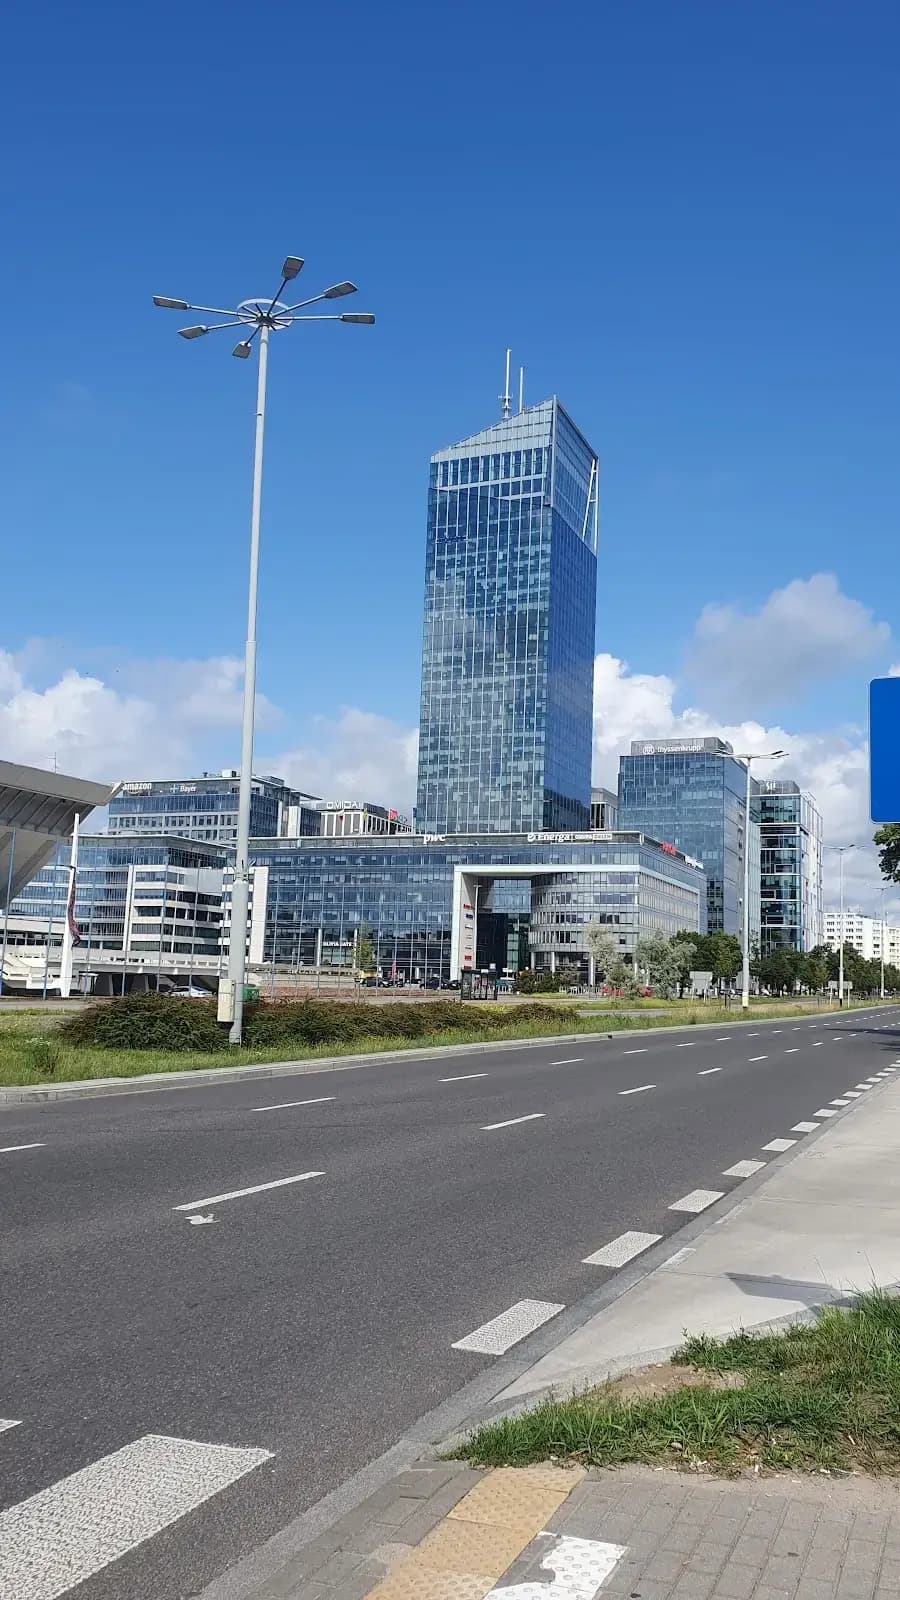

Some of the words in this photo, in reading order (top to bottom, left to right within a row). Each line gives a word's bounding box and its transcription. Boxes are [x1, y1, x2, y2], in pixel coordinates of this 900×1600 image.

[657, 744, 701, 754] thyssenkrupp
[180, 785, 197, 793] Bayer
[423, 834, 446, 844] pwc
[538, 833, 570, 842] Energa
